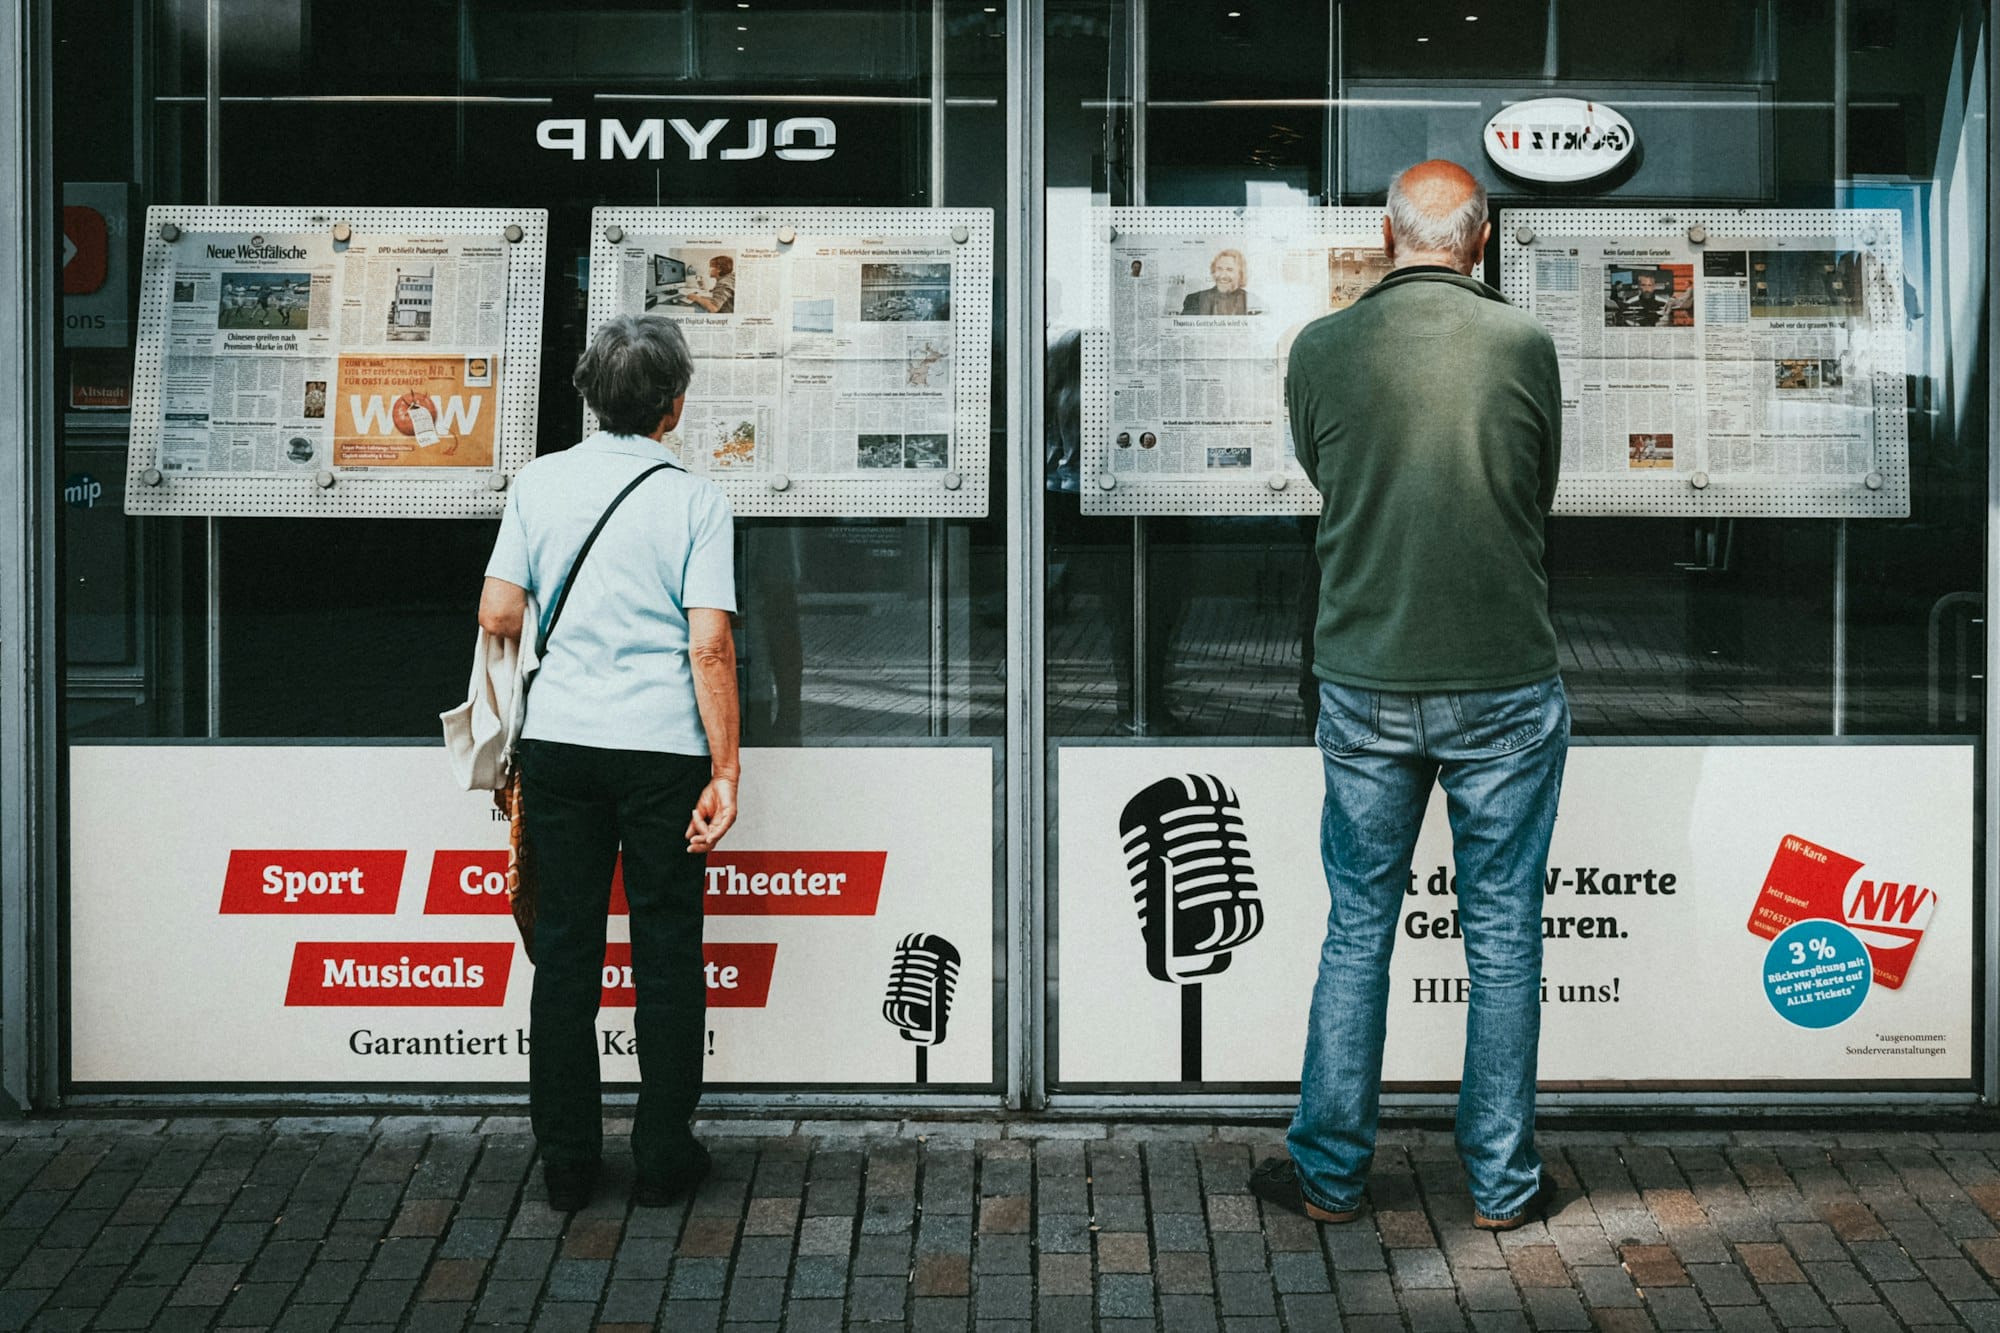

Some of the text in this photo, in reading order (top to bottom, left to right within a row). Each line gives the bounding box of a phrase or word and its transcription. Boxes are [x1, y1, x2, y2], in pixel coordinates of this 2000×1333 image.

[206, 244, 307, 260] Neue Westfälische
[66, 315, 106, 329] ons
[227, 333, 296, 343] Chinesen greifen nach
[1785, 838, 1828, 864] NW-Karte
[262, 865, 365, 902] Sport
[705, 865, 847, 896] Theater
[1543, 868, 1677, 895] W-Karte
[1766, 886, 1810, 909] Jetzt sparen!
[1848, 880, 1930, 923] NW
[1405, 910, 1629, 938] Gel aren.
[1788, 937, 1836, 965] 3 %
[321, 956, 484, 989] Musicals
[1768, 957, 1865, 984] Rückvergütung mit
[1775, 970, 1863, 996] der NW-Karte auf
[1412, 978, 1472, 1003] HIE
[1558, 977, 1621, 1003] uns!
[1787, 993, 1813, 1006] ALLE
[349, 1029, 508, 1056] Garantiert
[1845, 1045, 1946, 1057] Sonderveranstaltungen
